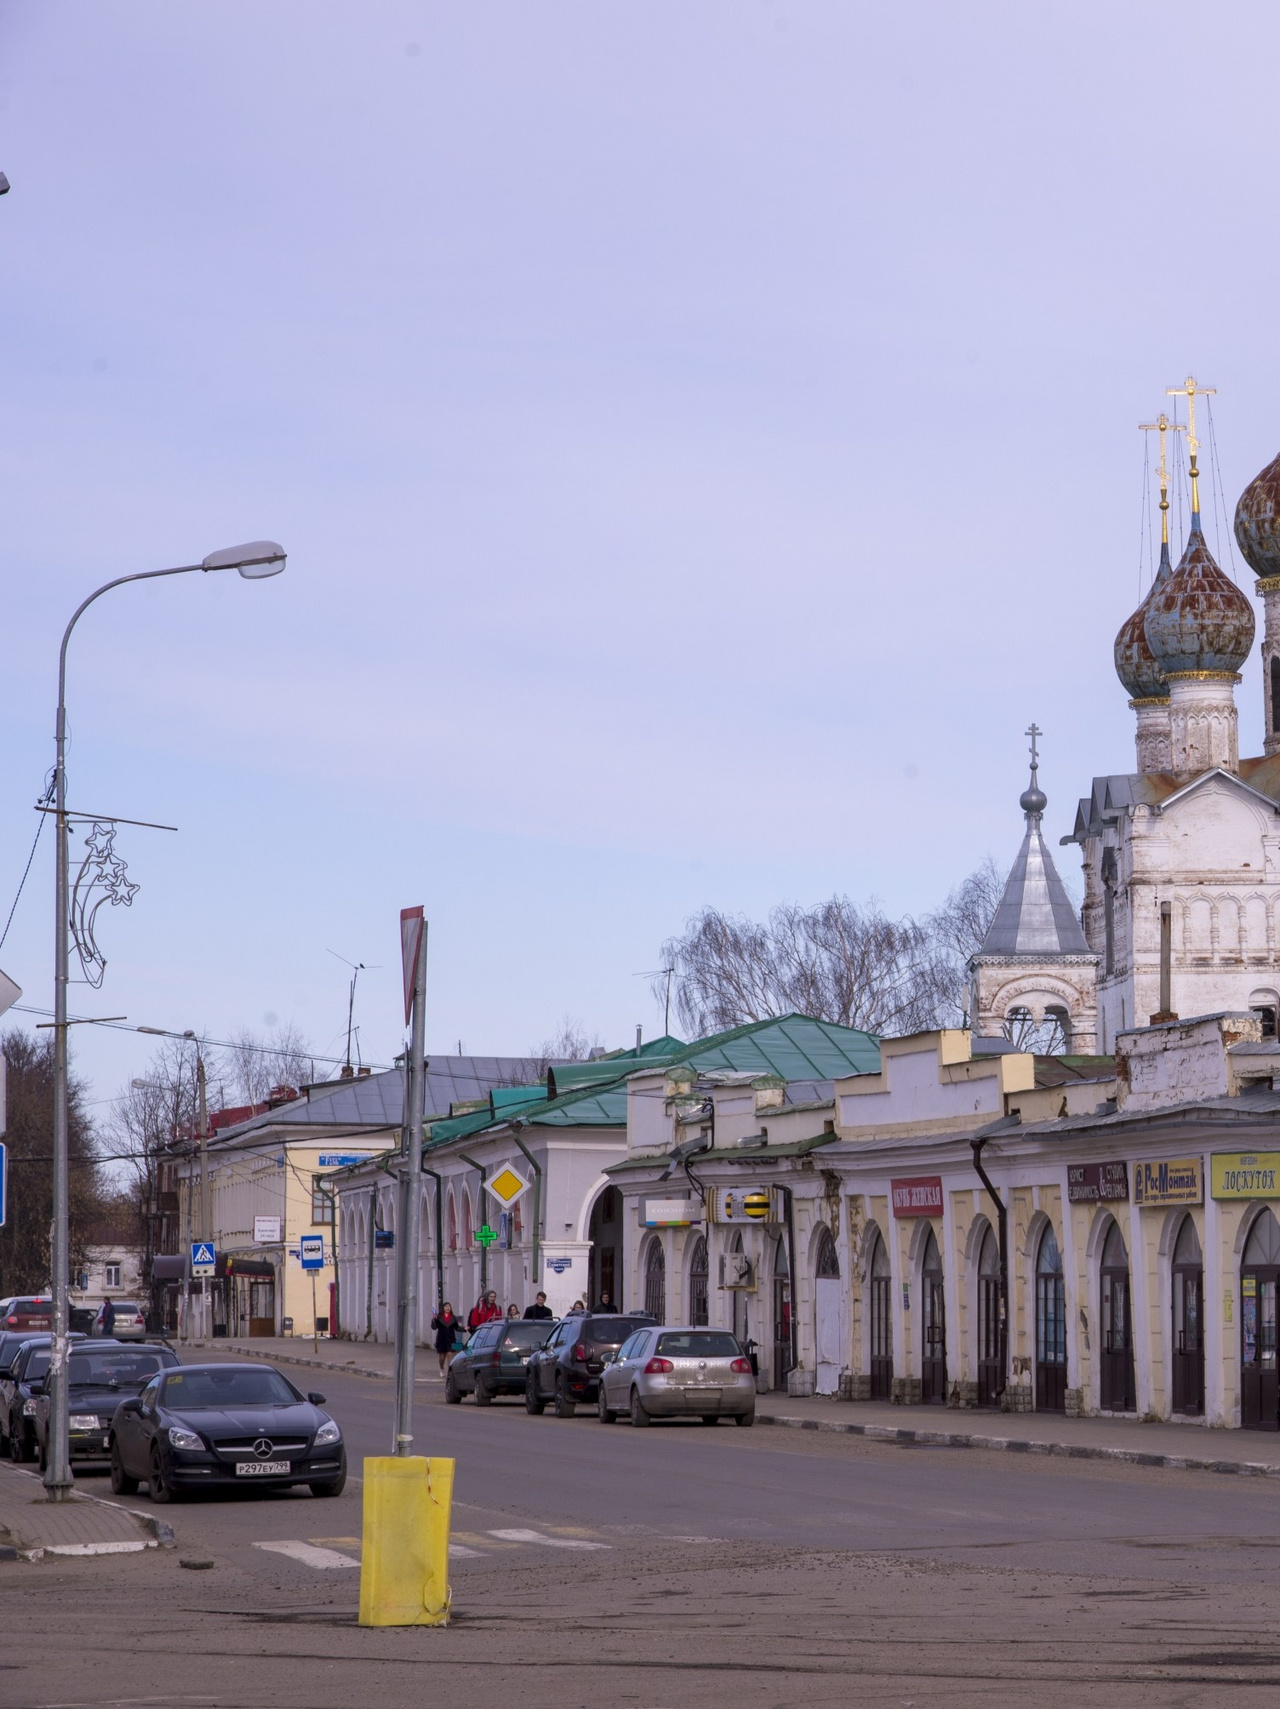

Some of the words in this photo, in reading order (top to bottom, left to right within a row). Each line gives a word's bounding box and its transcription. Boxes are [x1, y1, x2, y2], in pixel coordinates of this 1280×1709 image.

[1222, 1170, 1276, 1192] ЛОСКУТОК
[1069, 1185, 1100, 1200] ЕДВИЖИМОСТЬ
[239, 1463, 274, 1474] Р297ЕУ
[275, 1461, 288, 1470] 799
